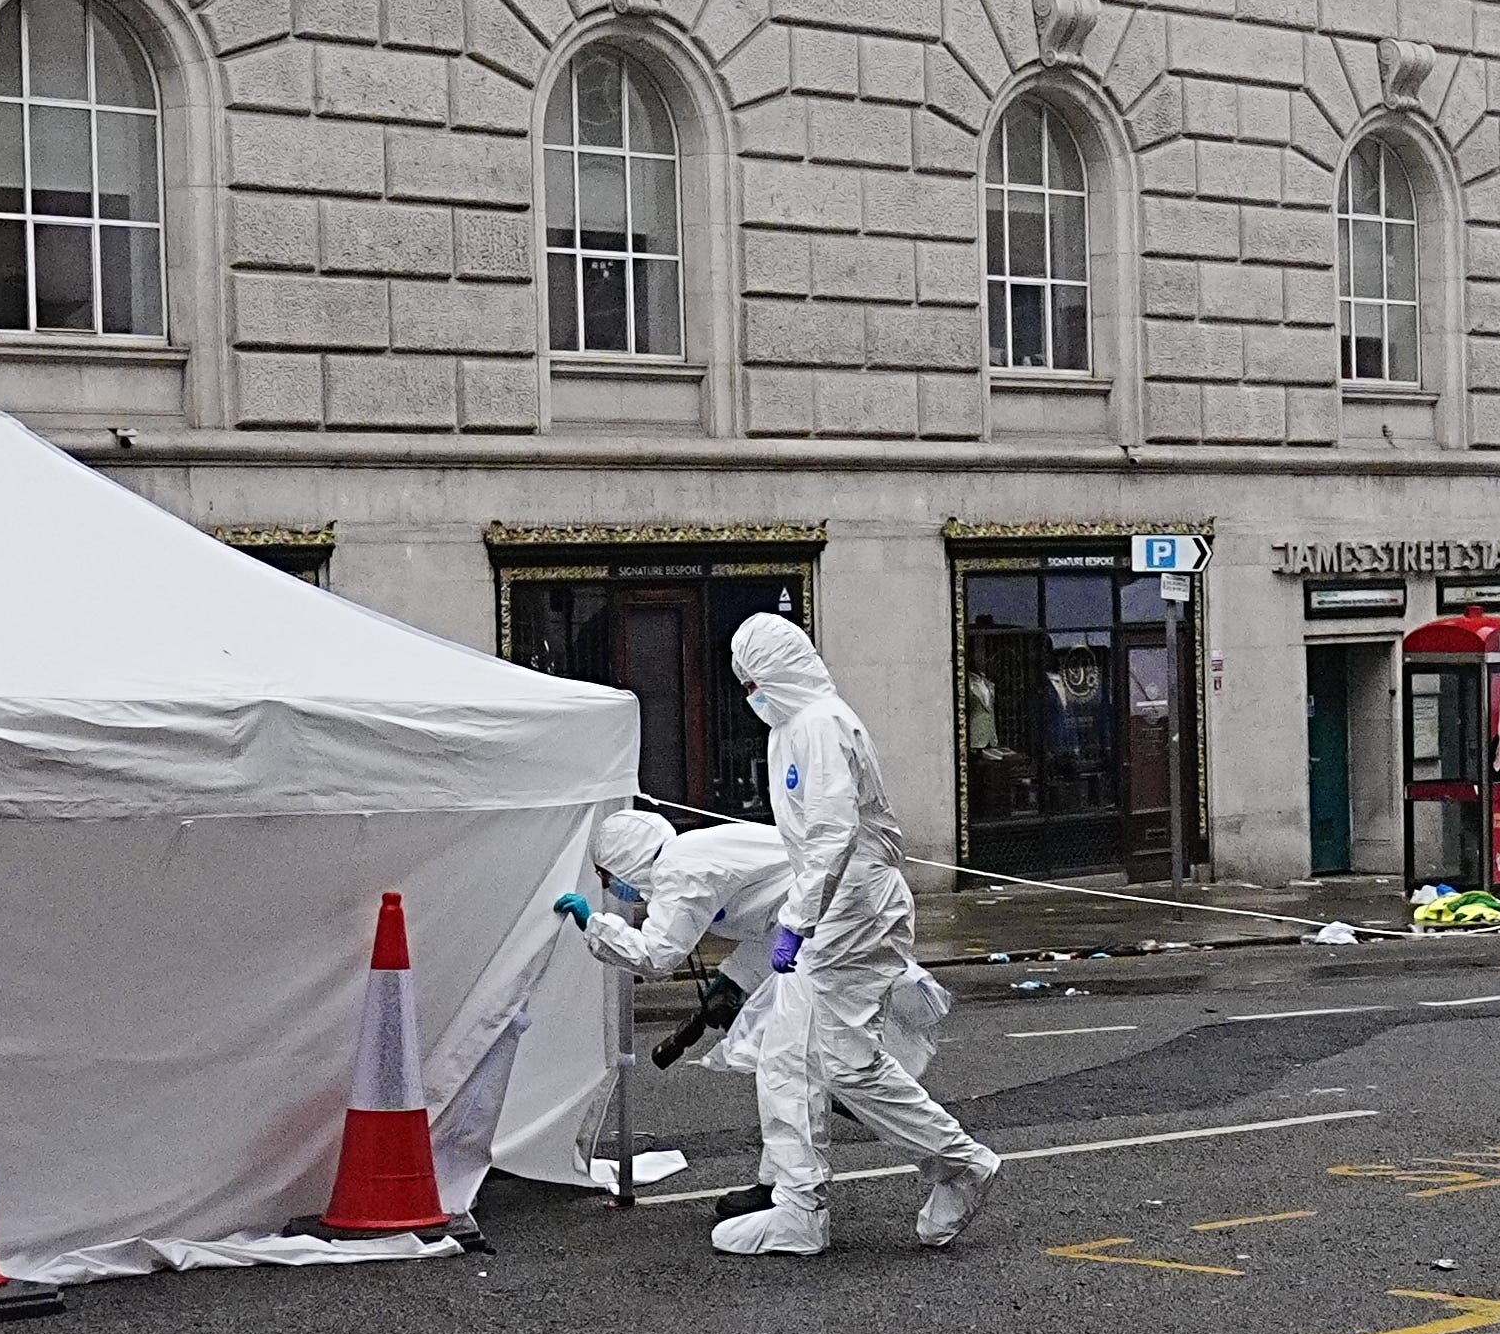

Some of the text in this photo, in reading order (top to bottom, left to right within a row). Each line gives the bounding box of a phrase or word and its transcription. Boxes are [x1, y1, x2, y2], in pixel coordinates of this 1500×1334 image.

[1152, 541, 1173, 566] P
[1271, 539, 1372, 574] JAMES
[1373, 539, 1461, 572] STREET
[618, 564, 703, 577] SIGNATURE BESPOKE
